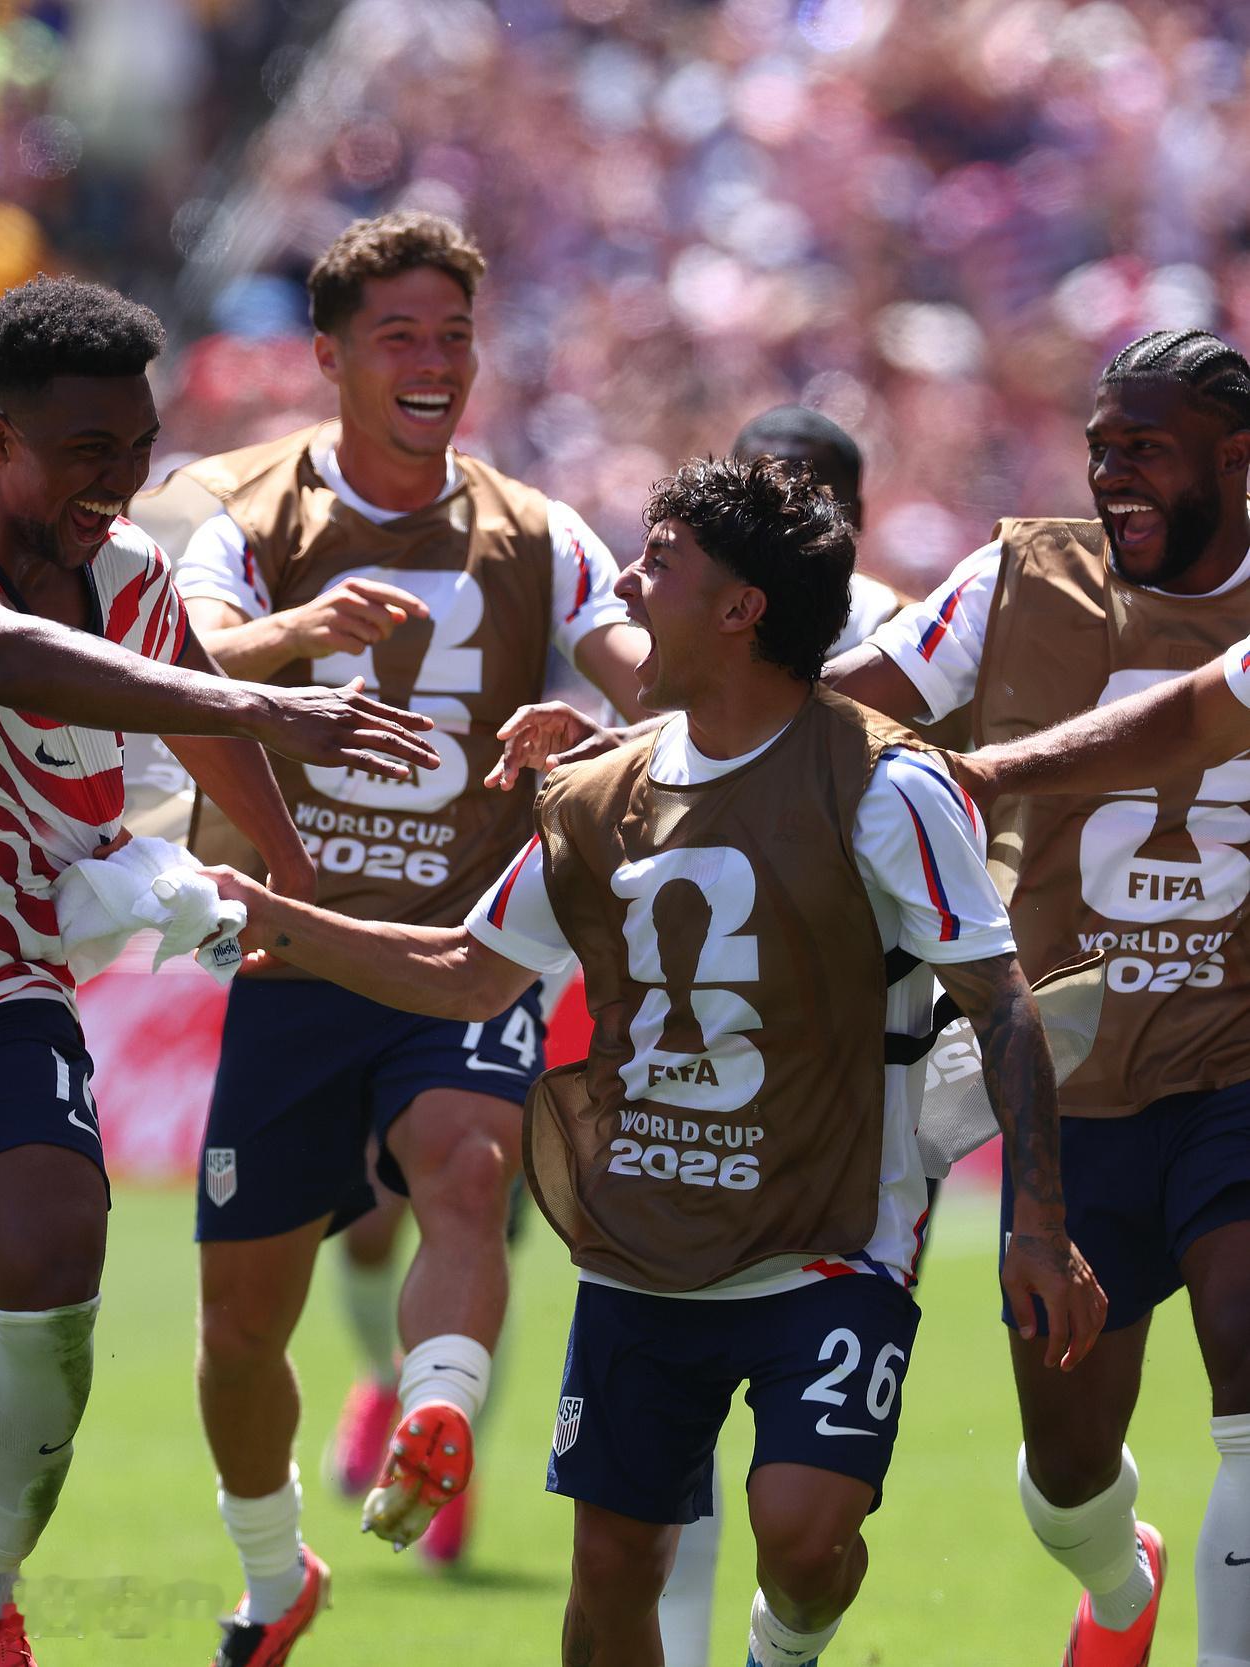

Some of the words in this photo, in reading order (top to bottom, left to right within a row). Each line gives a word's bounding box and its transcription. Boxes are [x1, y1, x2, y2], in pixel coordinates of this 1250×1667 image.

[295, 802, 395, 838] WORLD
[398, 819, 456, 847] CUP
[1127, 872, 1205, 901] FIFA
[1186, 931, 1234, 955] CU
[1107, 952, 1225, 993] 026
[618, 1110, 699, 1143] WORLD
[705, 1125, 765, 1148] CUP
[608, 1138, 760, 1191] 2026
[800, 1327, 904, 1421] 26
